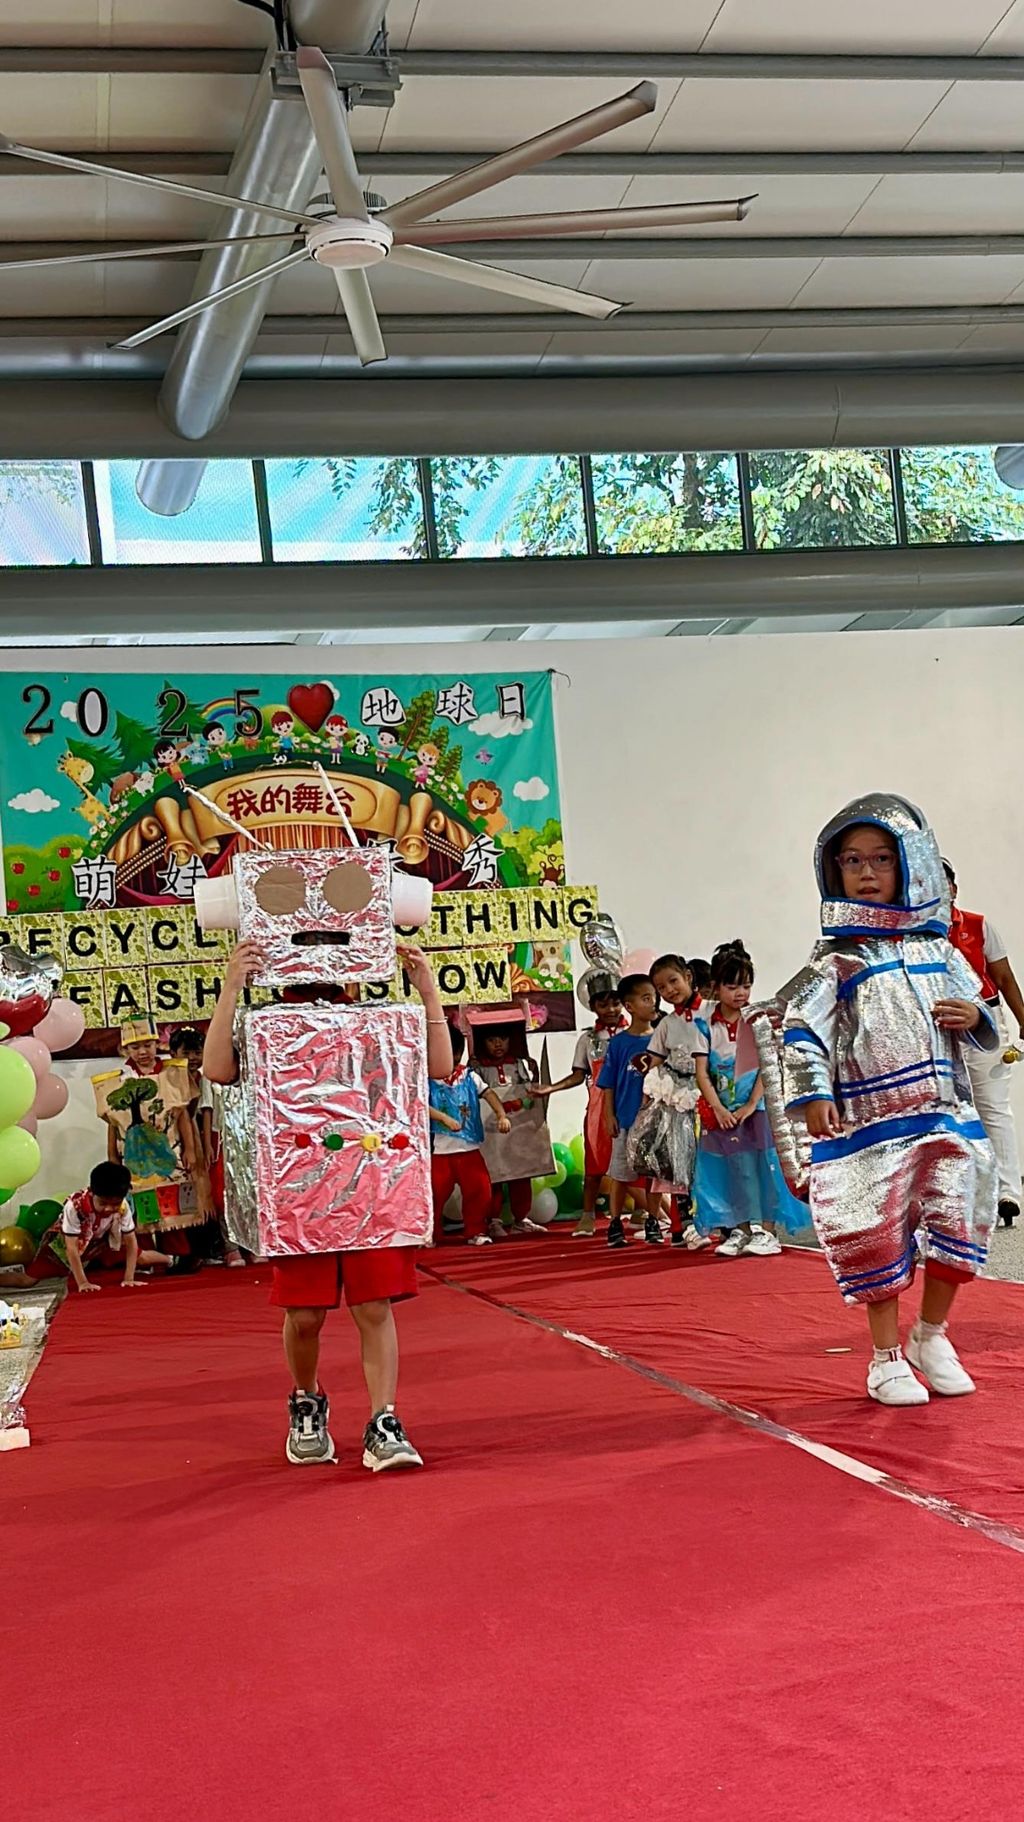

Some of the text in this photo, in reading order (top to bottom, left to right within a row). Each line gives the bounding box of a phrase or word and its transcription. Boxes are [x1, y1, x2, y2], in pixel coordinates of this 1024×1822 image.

[363, 682, 525, 723] 地球日
[227, 783, 355, 820] 我的舞台
[0, 899, 593, 957] ECYCL THING
